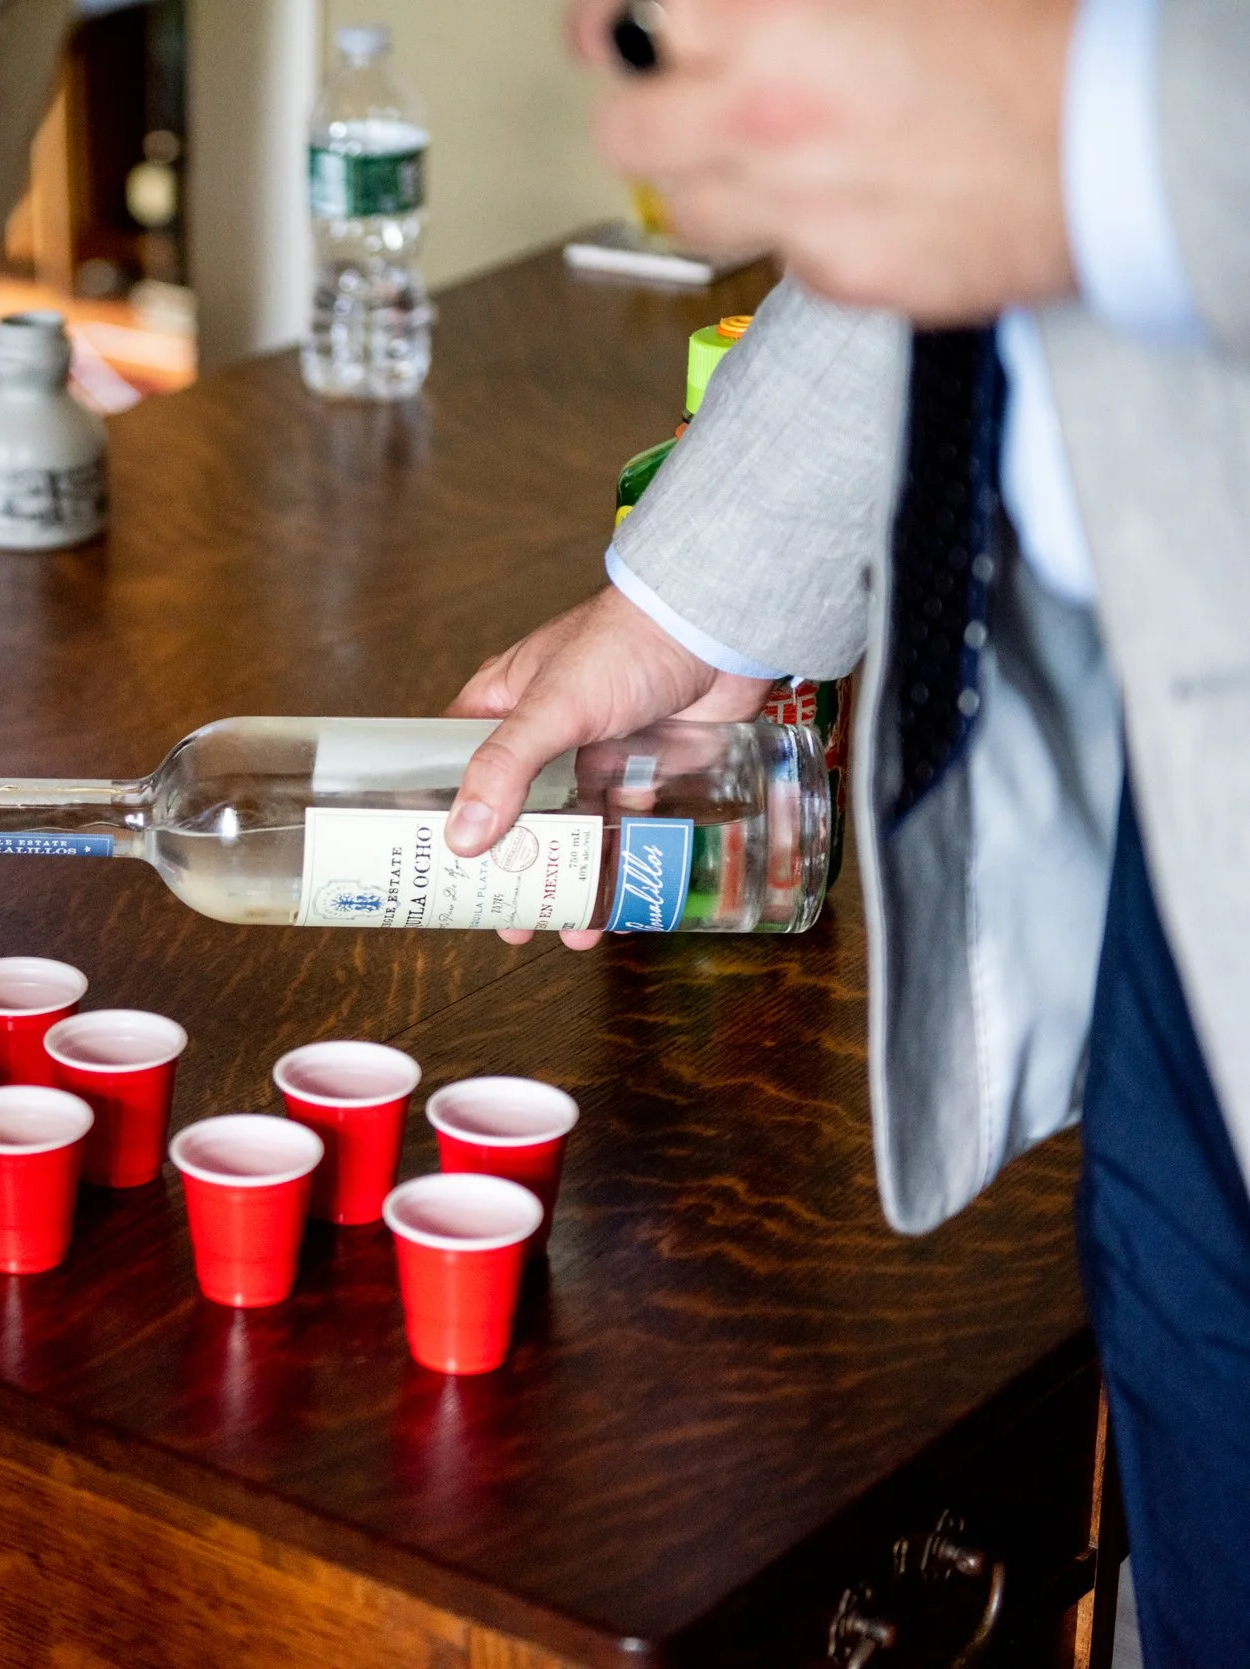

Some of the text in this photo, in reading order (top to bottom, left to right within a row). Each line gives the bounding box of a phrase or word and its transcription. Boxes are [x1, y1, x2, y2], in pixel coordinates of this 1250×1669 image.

[19, 839, 68, 847] ESTATE
[568, 851, 578, 868] 750
[387, 846, 402, 903] ESTATE
[403, 826, 433, 928] UILA OCHO
[476, 860, 489, 898] PLATA
[544, 840, 561, 900] MEXICO
[539, 900, 552, 918] EN
